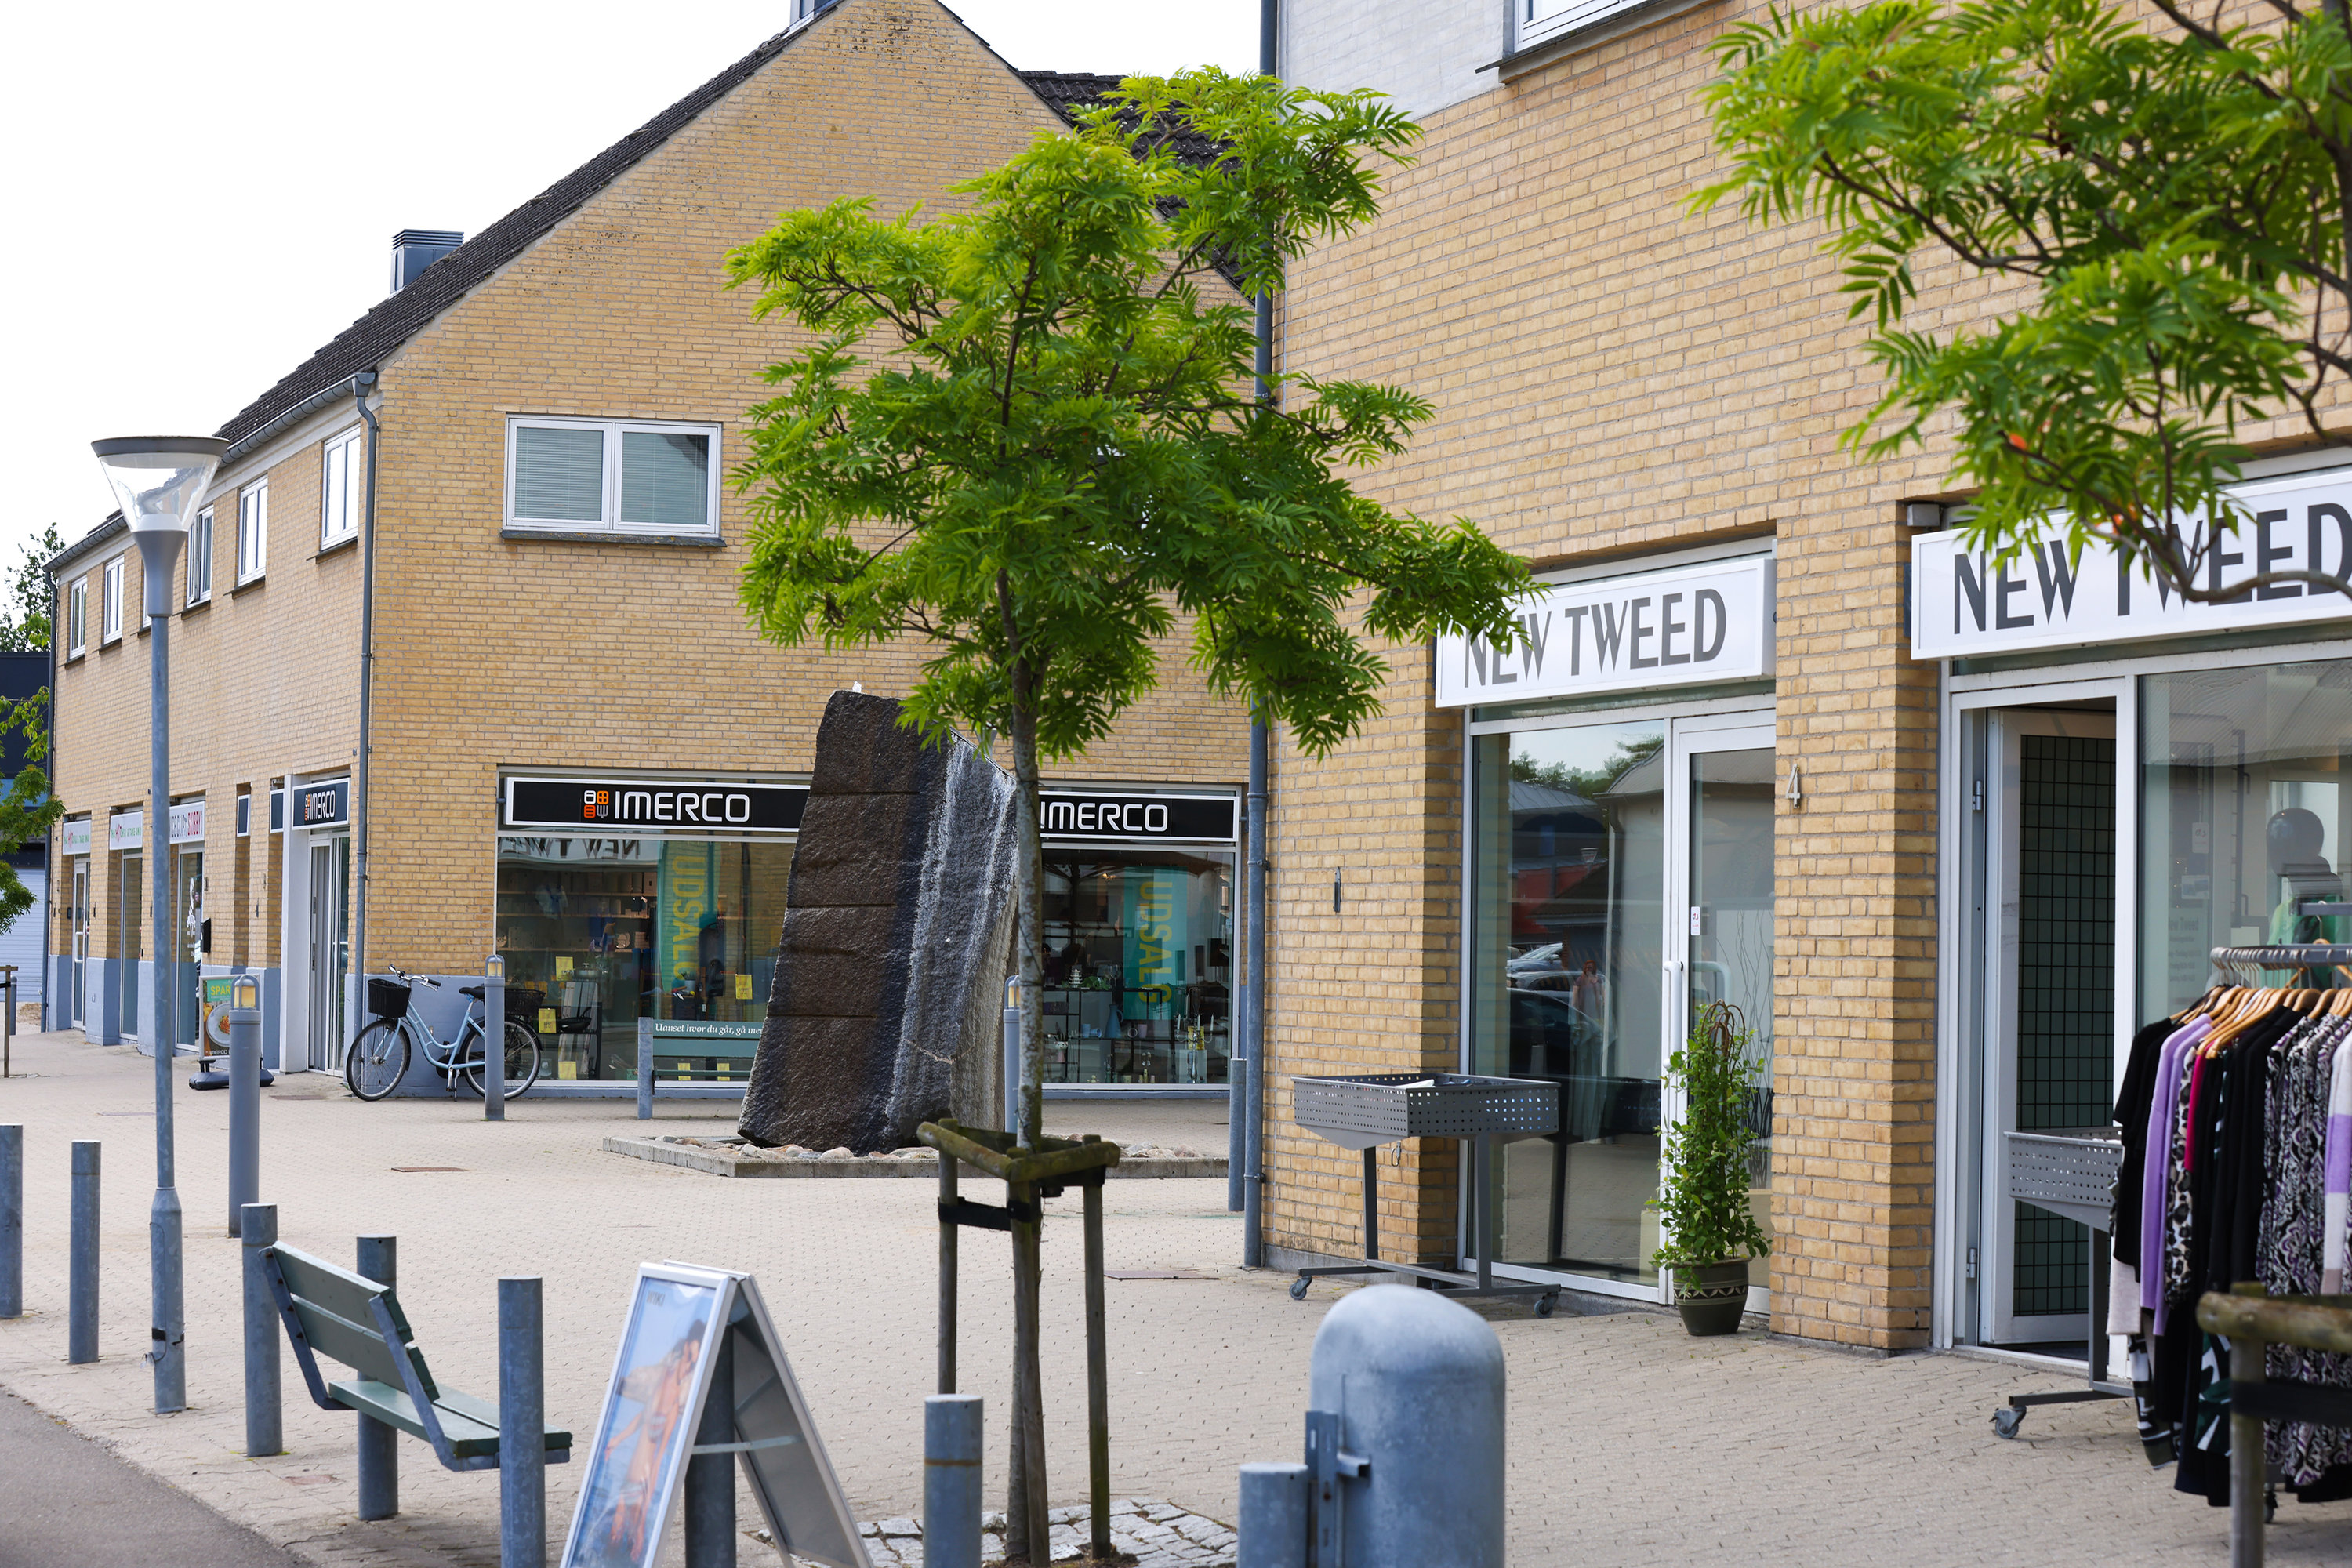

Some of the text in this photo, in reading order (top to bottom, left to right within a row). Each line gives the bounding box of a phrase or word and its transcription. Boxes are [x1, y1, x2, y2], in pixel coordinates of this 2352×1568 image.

[1955, 503, 2352, 634] NEW TWEED
[1465, 589, 1726, 688] NEW TWEED
[1785, 764, 1801, 808] 4
[310, 790, 336, 821] IMERCO
[615, 790, 750, 822] IMERCO
[1040, 801, 1168, 832] IMERCO
[1138, 881, 1173, 1004] UDSALG
[210, 985, 231, 996] SPAR
[655, 1023, 684, 1032] Uanset
[686, 1024, 706, 1033] hvor
[718, 1025, 735, 1036] går,
[735, 1025, 746, 1036] gå
